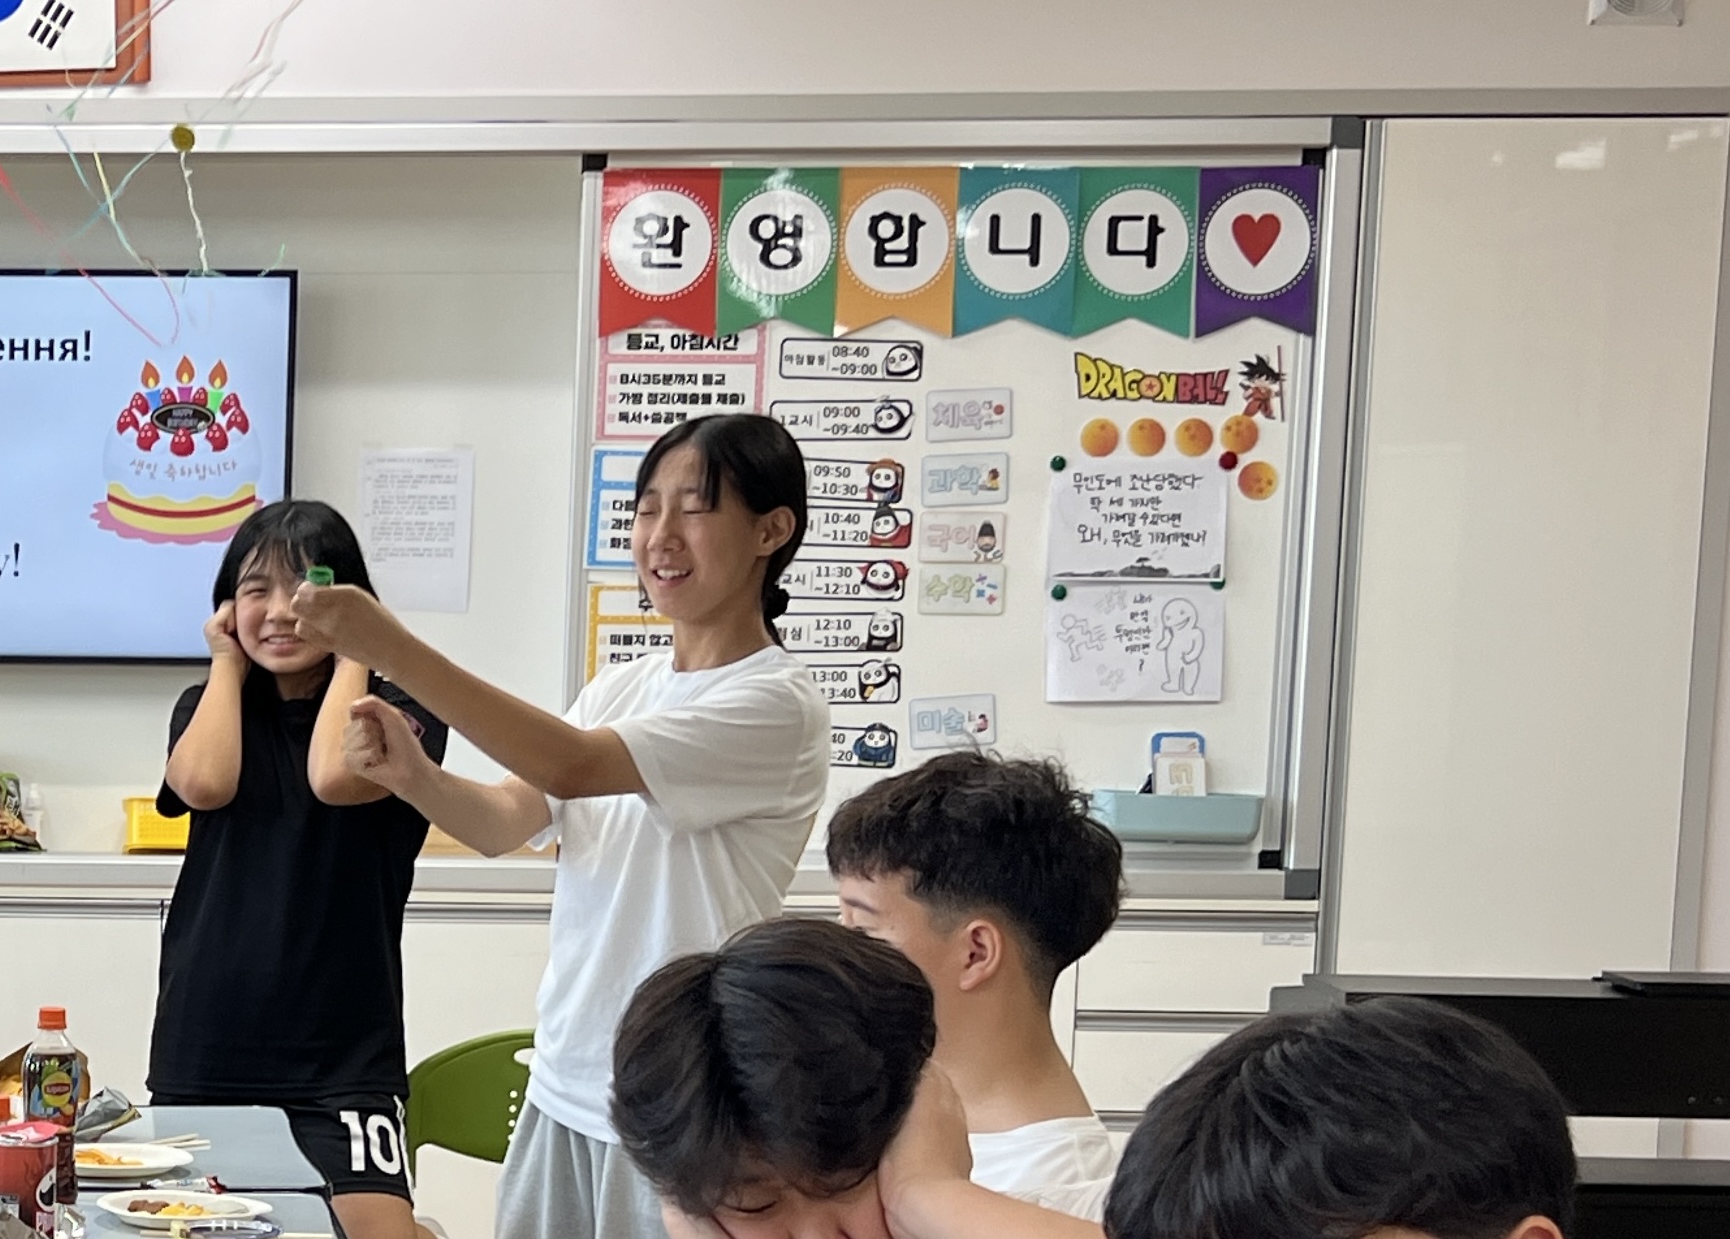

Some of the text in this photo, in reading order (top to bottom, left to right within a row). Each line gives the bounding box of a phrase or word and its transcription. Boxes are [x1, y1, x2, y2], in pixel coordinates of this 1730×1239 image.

[670, 333, 740, 350] 아침시간
[832, 346, 869, 358] 08:40
[831, 363, 877, 375] ~09:00
[823, 406, 860, 418] 09:00
[932, 400, 984, 431] 체육
[822, 423, 869, 436] ~09:40
[129, 459, 238, 482] 생일 축하합니다
[813, 465, 851, 478] 09:50
[927, 465, 982, 496] 과학
[1073, 472, 1122, 494] 무인도에
[812, 483, 858, 496] ~10:30
[824, 512, 861, 525] 10:40
[822, 530, 868, 542] ~11:20
[926, 524, 978, 553] 국어
[816, 566, 853, 578] 11:30
[814, 583, 861, 596] ~12:10
[926, 574, 975, 603] 수학
[815, 619, 852, 631] 12:10
[813, 635, 860, 648] ~13:00
[916, 707, 966, 735] 미술
[338, 1111, 401, 1176] 10
